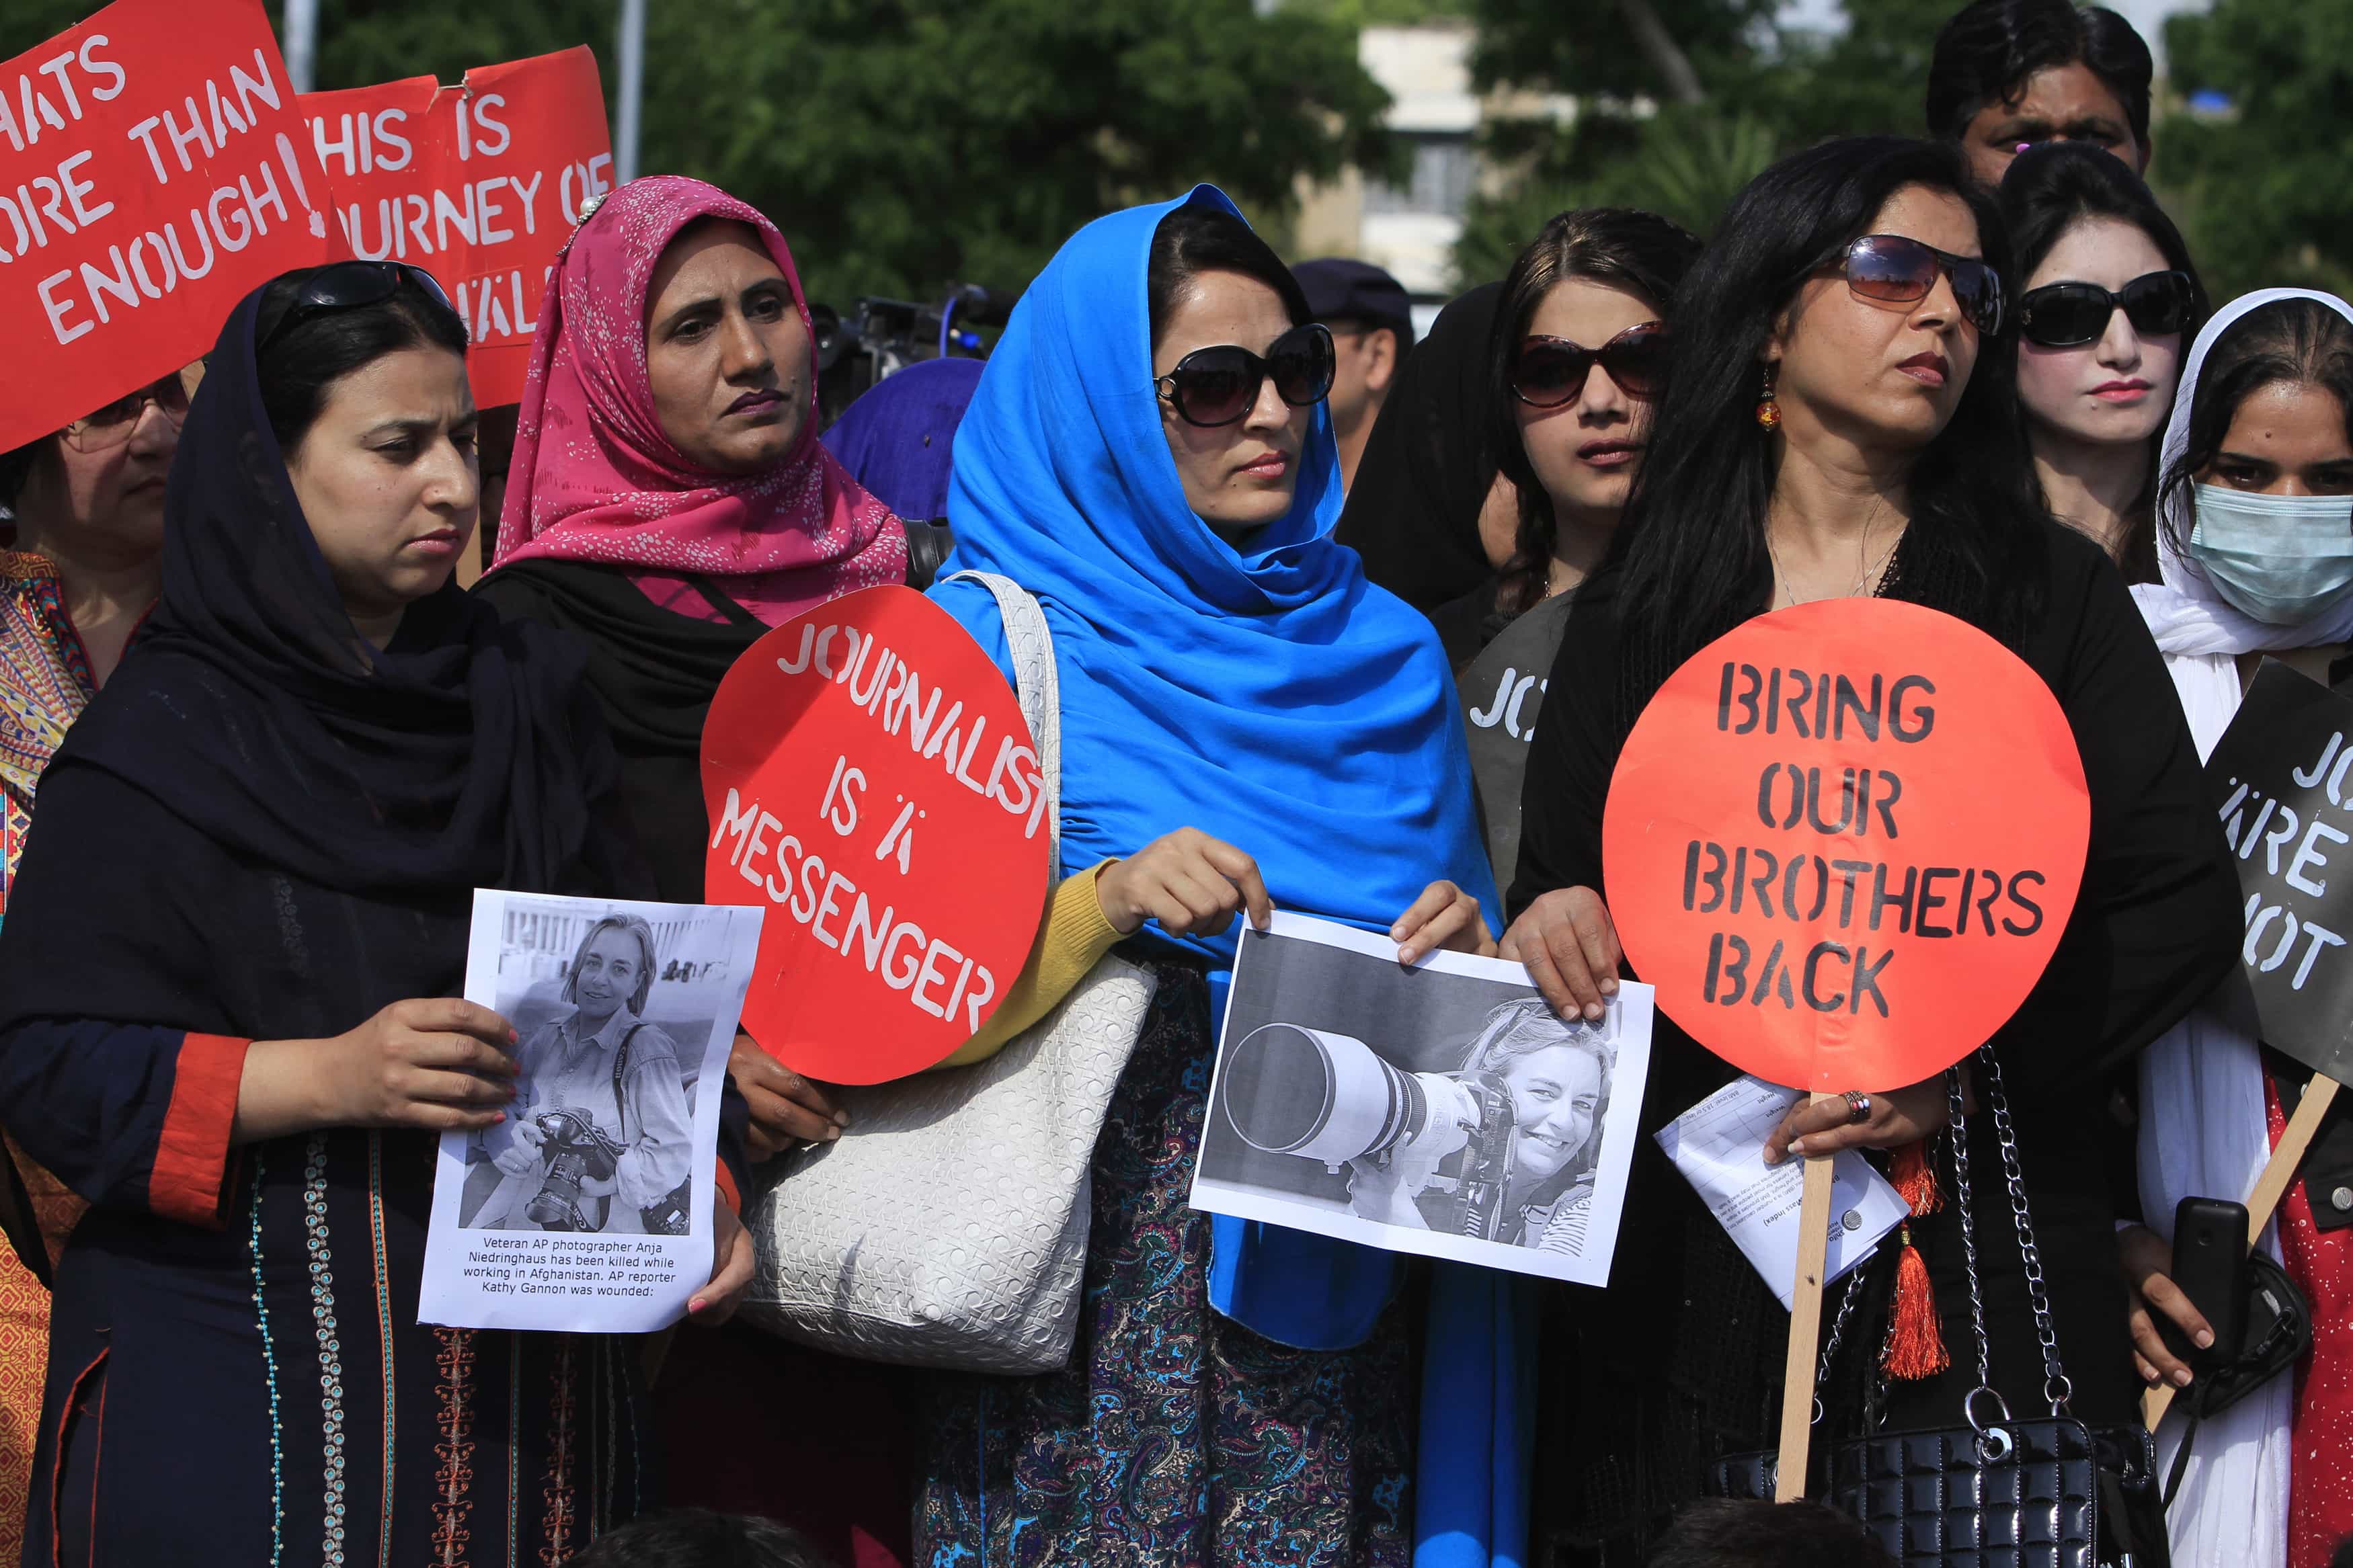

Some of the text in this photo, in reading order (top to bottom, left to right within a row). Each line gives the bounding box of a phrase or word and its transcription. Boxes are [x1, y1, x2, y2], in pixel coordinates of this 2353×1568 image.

[128, 49, 280, 183] THAN
[305, 94, 510, 175] HIS IS
[561, 153, 611, 226] OF
[38, 132, 326, 345] ENOUGH!
[777, 623, 1048, 838] JOURNALIST
[1718, 663, 1935, 743] BRING
[821, 755, 867, 836] IS
[1758, 764, 1901, 839] OUR
[713, 788, 995, 1034] MESSENGER
[1684, 841, 2045, 938] BROTHERS
[1704, 934, 1893, 1017] BACK
[2243, 893, 2347, 990] OT
[1756, 1091, 1776, 1105] Height
[1764, 1103, 1786, 1118] Weight
[484, 1238, 663, 1255] Veteran AP photographer Anja
[1761, 1208, 1786, 1227] Index)
[1827, 1229, 1845, 1243] Shifa
[464, 1266, 676, 1284] working in Afghanistan. AP reporter
[469, 1251, 674, 1268] Niedringhaus has been killed while
[483, 1282, 654, 1296] Kathy Gannon was wounded:
